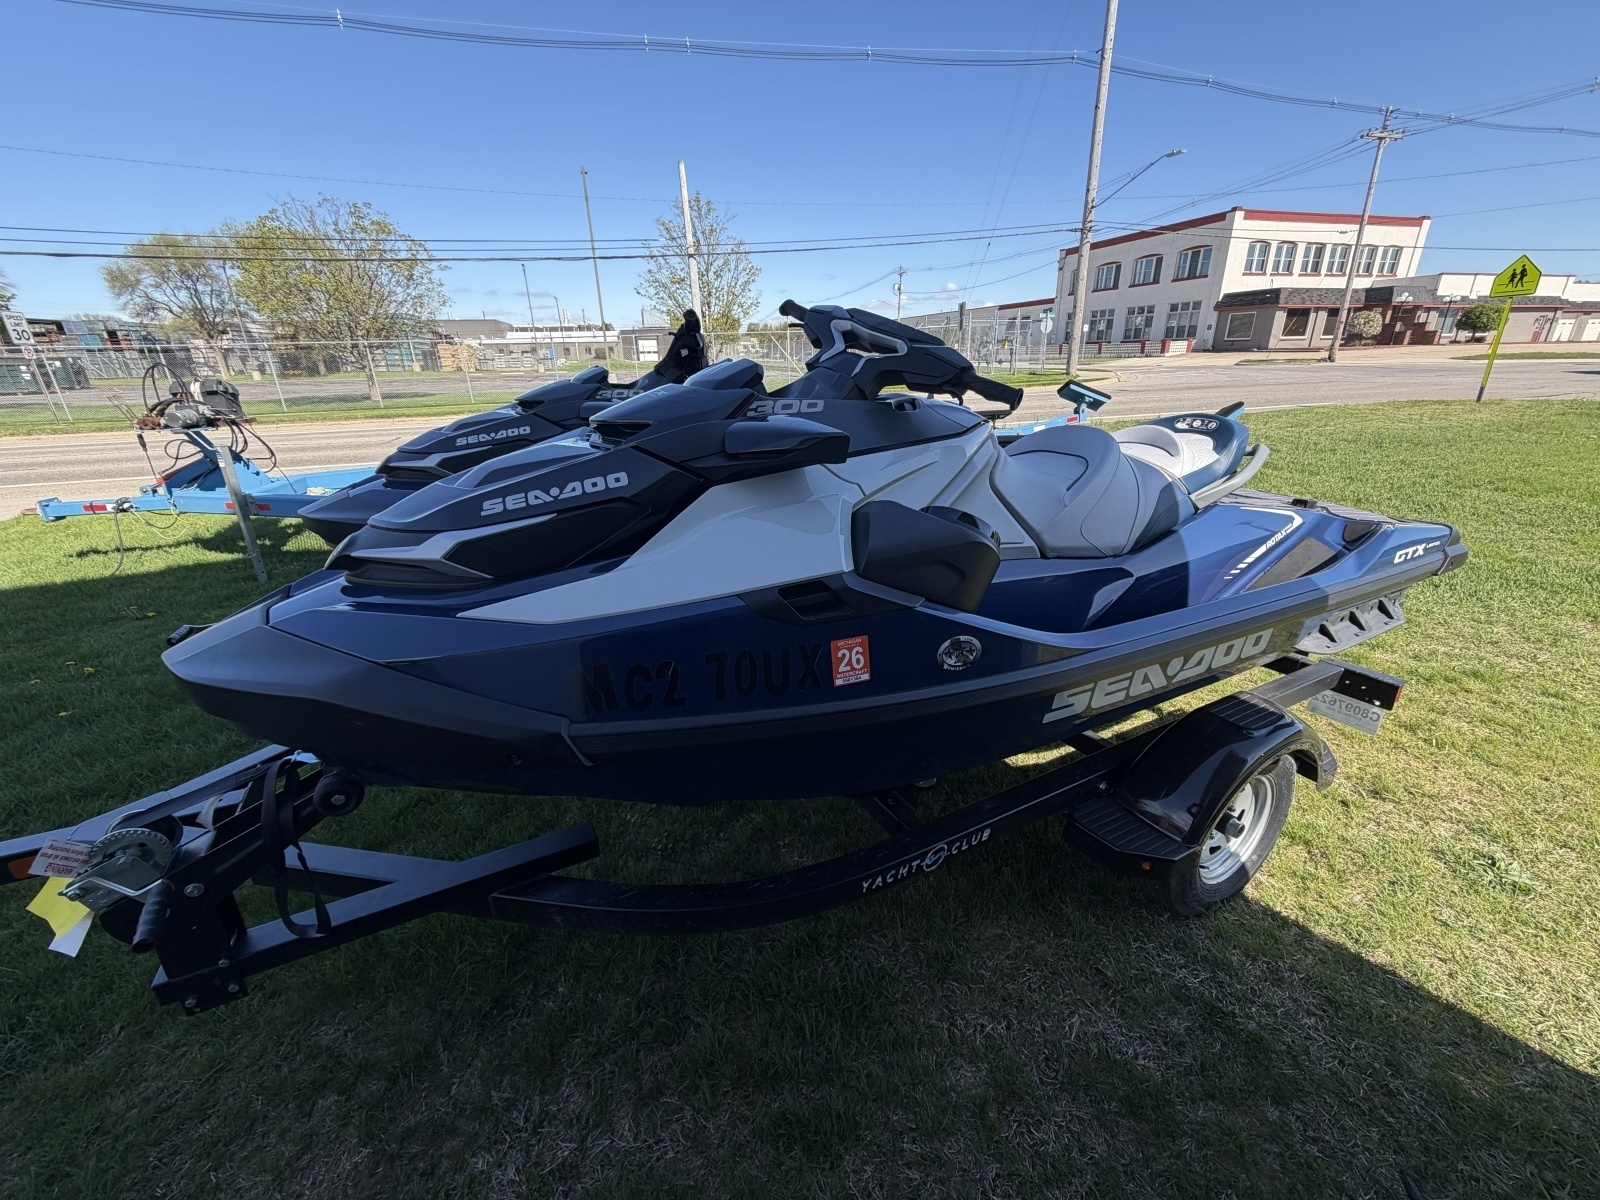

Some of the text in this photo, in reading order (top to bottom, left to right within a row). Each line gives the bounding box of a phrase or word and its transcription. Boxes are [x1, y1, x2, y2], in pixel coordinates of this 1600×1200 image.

[12, 329, 31, 341] 30
[596, 389, 642, 399] 300
[746, 399, 825, 417] 300
[1265, 529, 1288, 550] ROTAX
[1393, 543, 1428, 564] GTX
[837, 638, 863, 646] MICHIGAN
[837, 646, 865, 673] 26
[836, 668, 868, 679] WATERCRAFT
[861, 827, 992, 893] YACHT CLUB
[44, 864, 77, 875] WARNING
